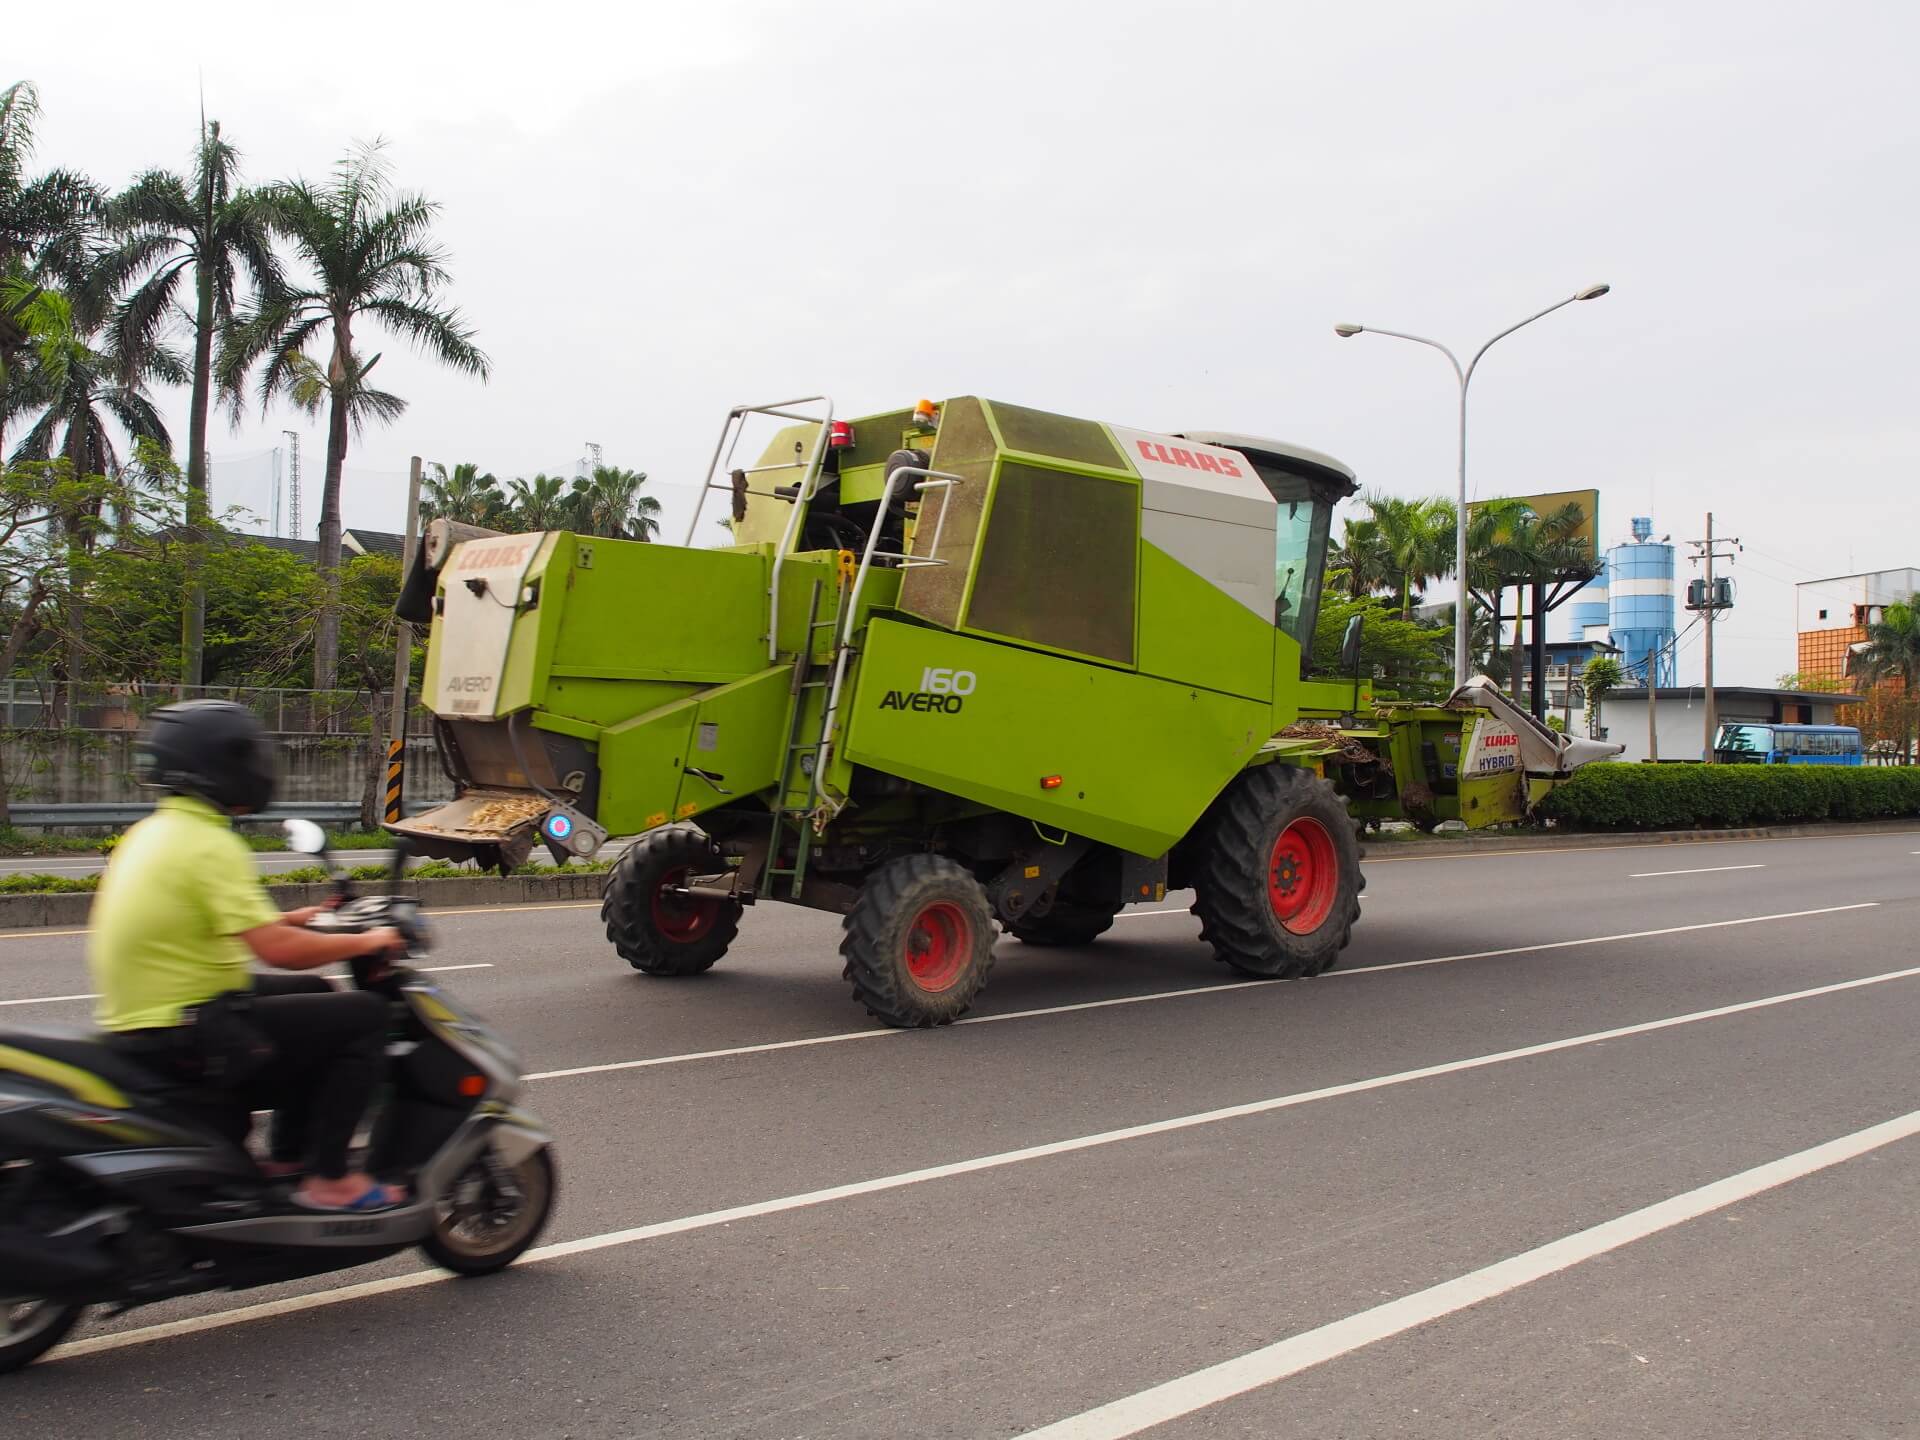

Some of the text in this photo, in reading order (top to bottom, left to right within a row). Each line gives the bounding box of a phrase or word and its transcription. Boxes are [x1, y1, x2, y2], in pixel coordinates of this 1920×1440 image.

[1136, 440, 1242, 478] CLAAS
[458, 544, 531, 571] CLAAS
[446, 676, 493, 693] AVERO
[920, 666, 977, 695] 160
[879, 690, 963, 714] AVERO
[1484, 734, 1519, 747] CLAAS
[1480, 754, 1515, 770] HYBRID
